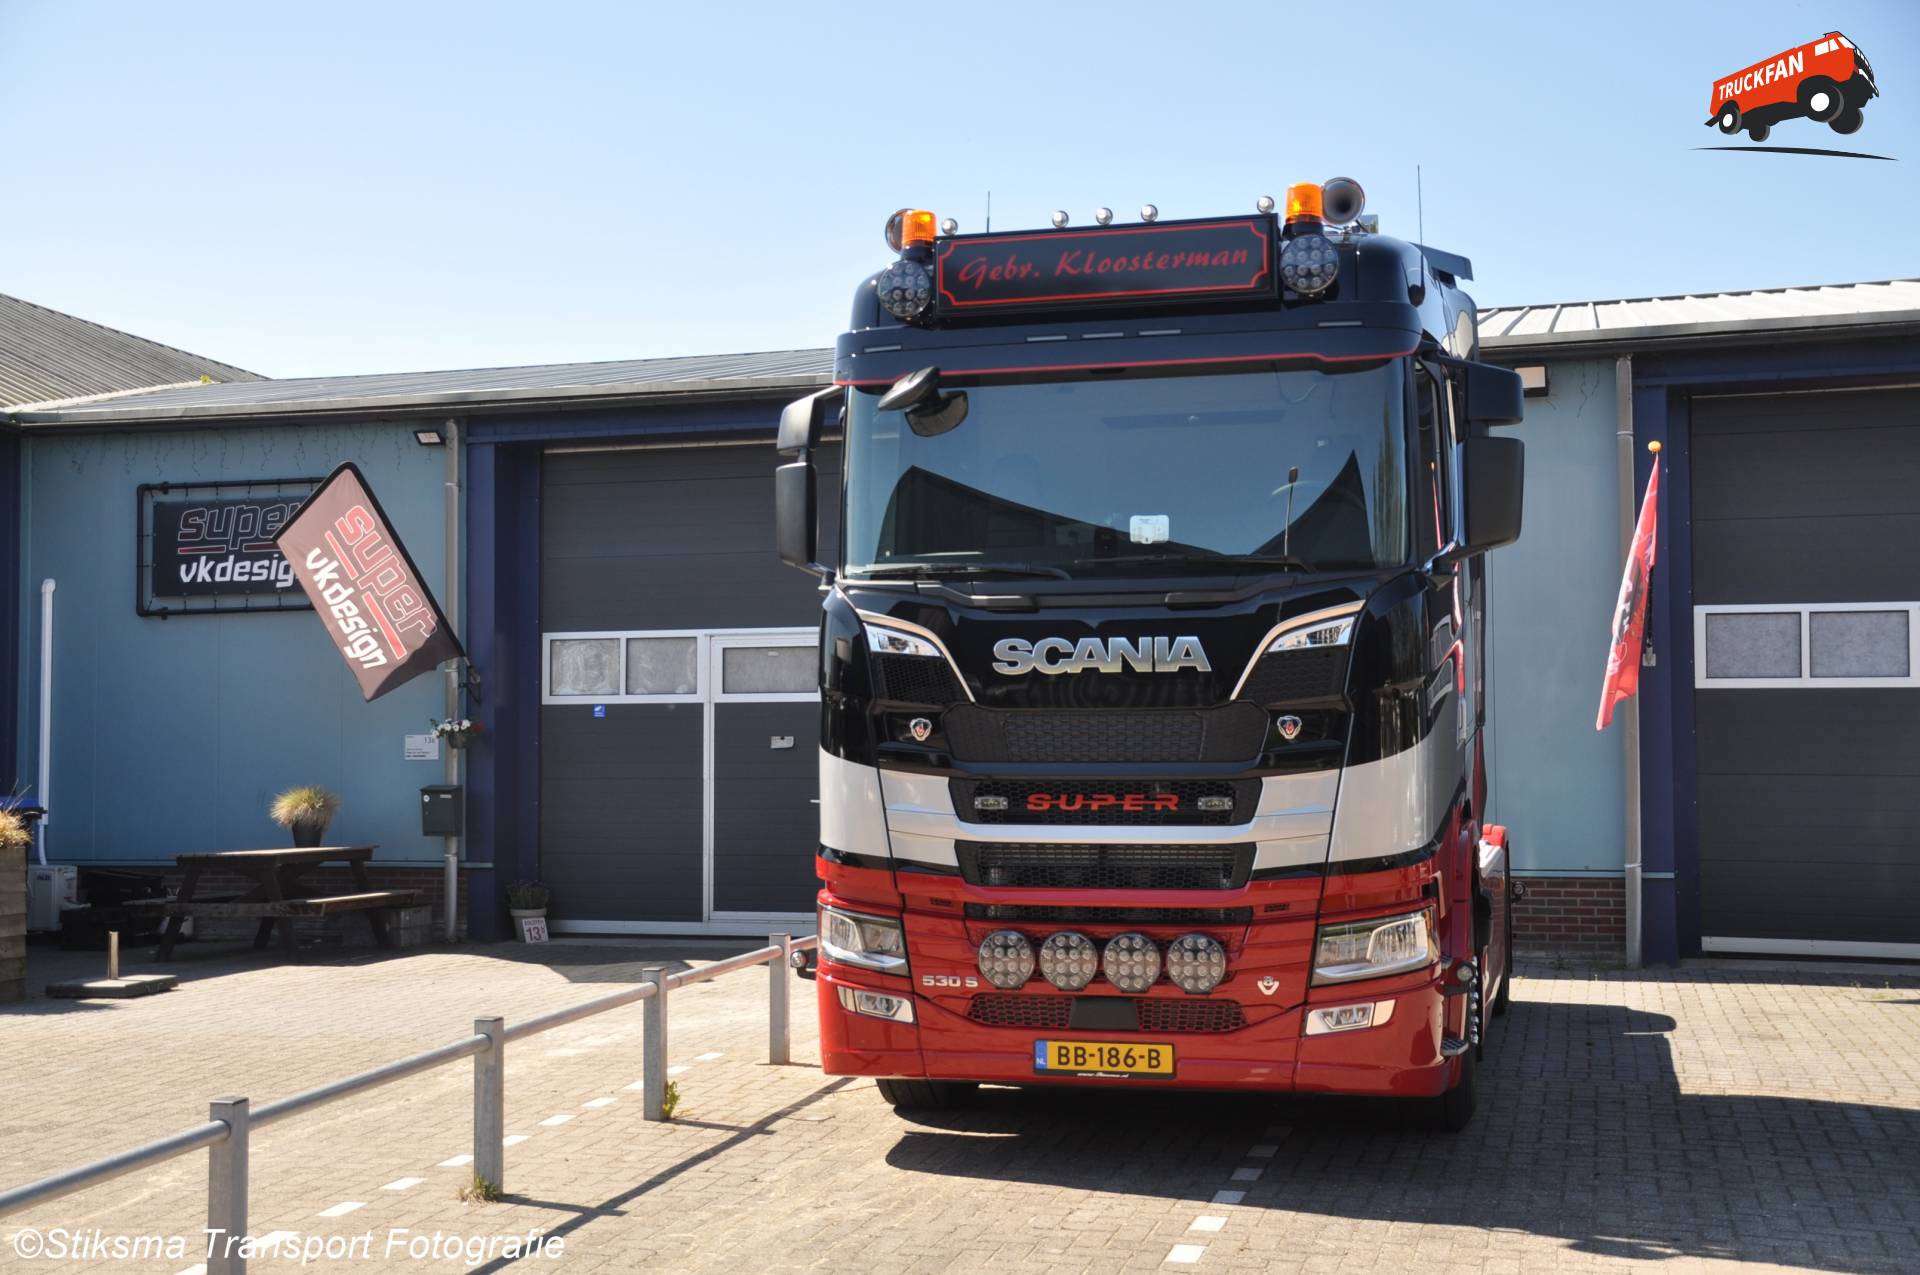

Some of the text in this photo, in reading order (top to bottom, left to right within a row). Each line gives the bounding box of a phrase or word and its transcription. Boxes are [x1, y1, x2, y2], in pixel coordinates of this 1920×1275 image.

[958, 248, 1249, 289] Gebr. Kloosterman
[179, 553, 298, 588] vkdesig
[335, 504, 437, 638] super
[305, 547, 388, 669] vkdesign
[992, 635, 1212, 676] SCANIA
[1026, 793, 1180, 811] SUPER
[922, 975, 979, 988] 530 S
[1036, 1057, 1047, 1066] NL
[1057, 1045, 1161, 1069] BB-186-B
